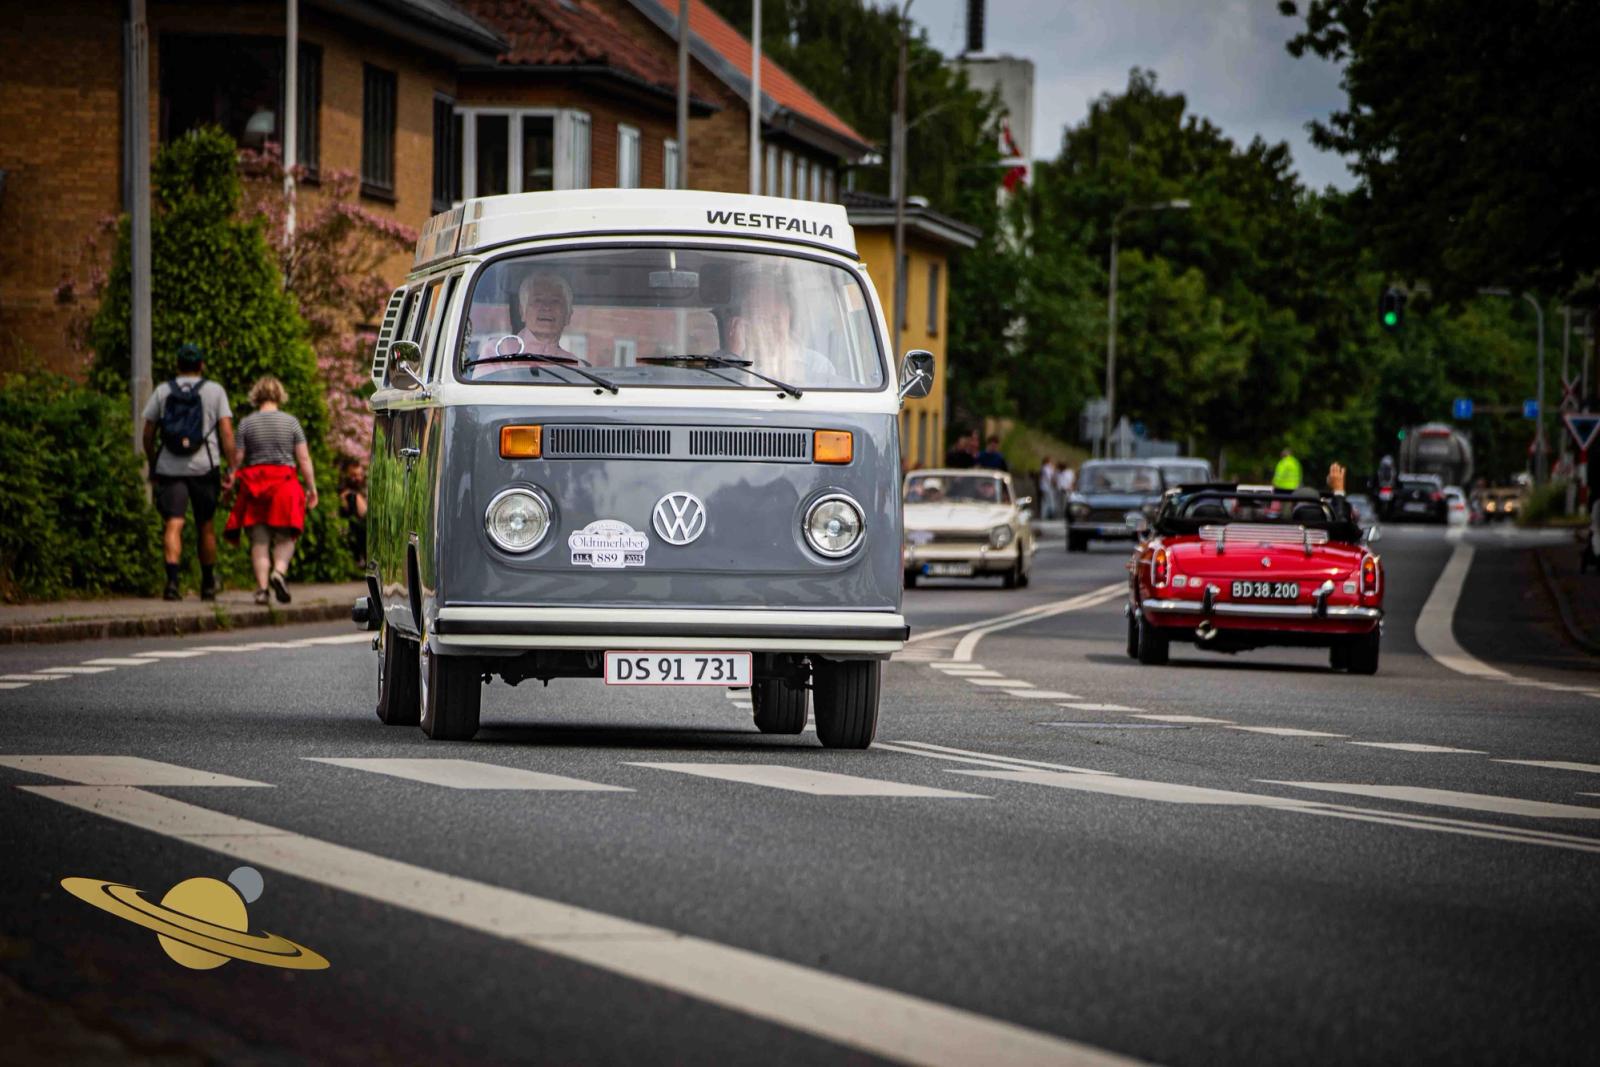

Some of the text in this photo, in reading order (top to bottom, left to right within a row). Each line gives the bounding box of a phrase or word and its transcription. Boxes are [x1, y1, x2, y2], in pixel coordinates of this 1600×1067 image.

[706, 210, 834, 239] WESTFALIA
[596, 553, 618, 563] 889
[616, 658, 738, 681] DS 91 731
